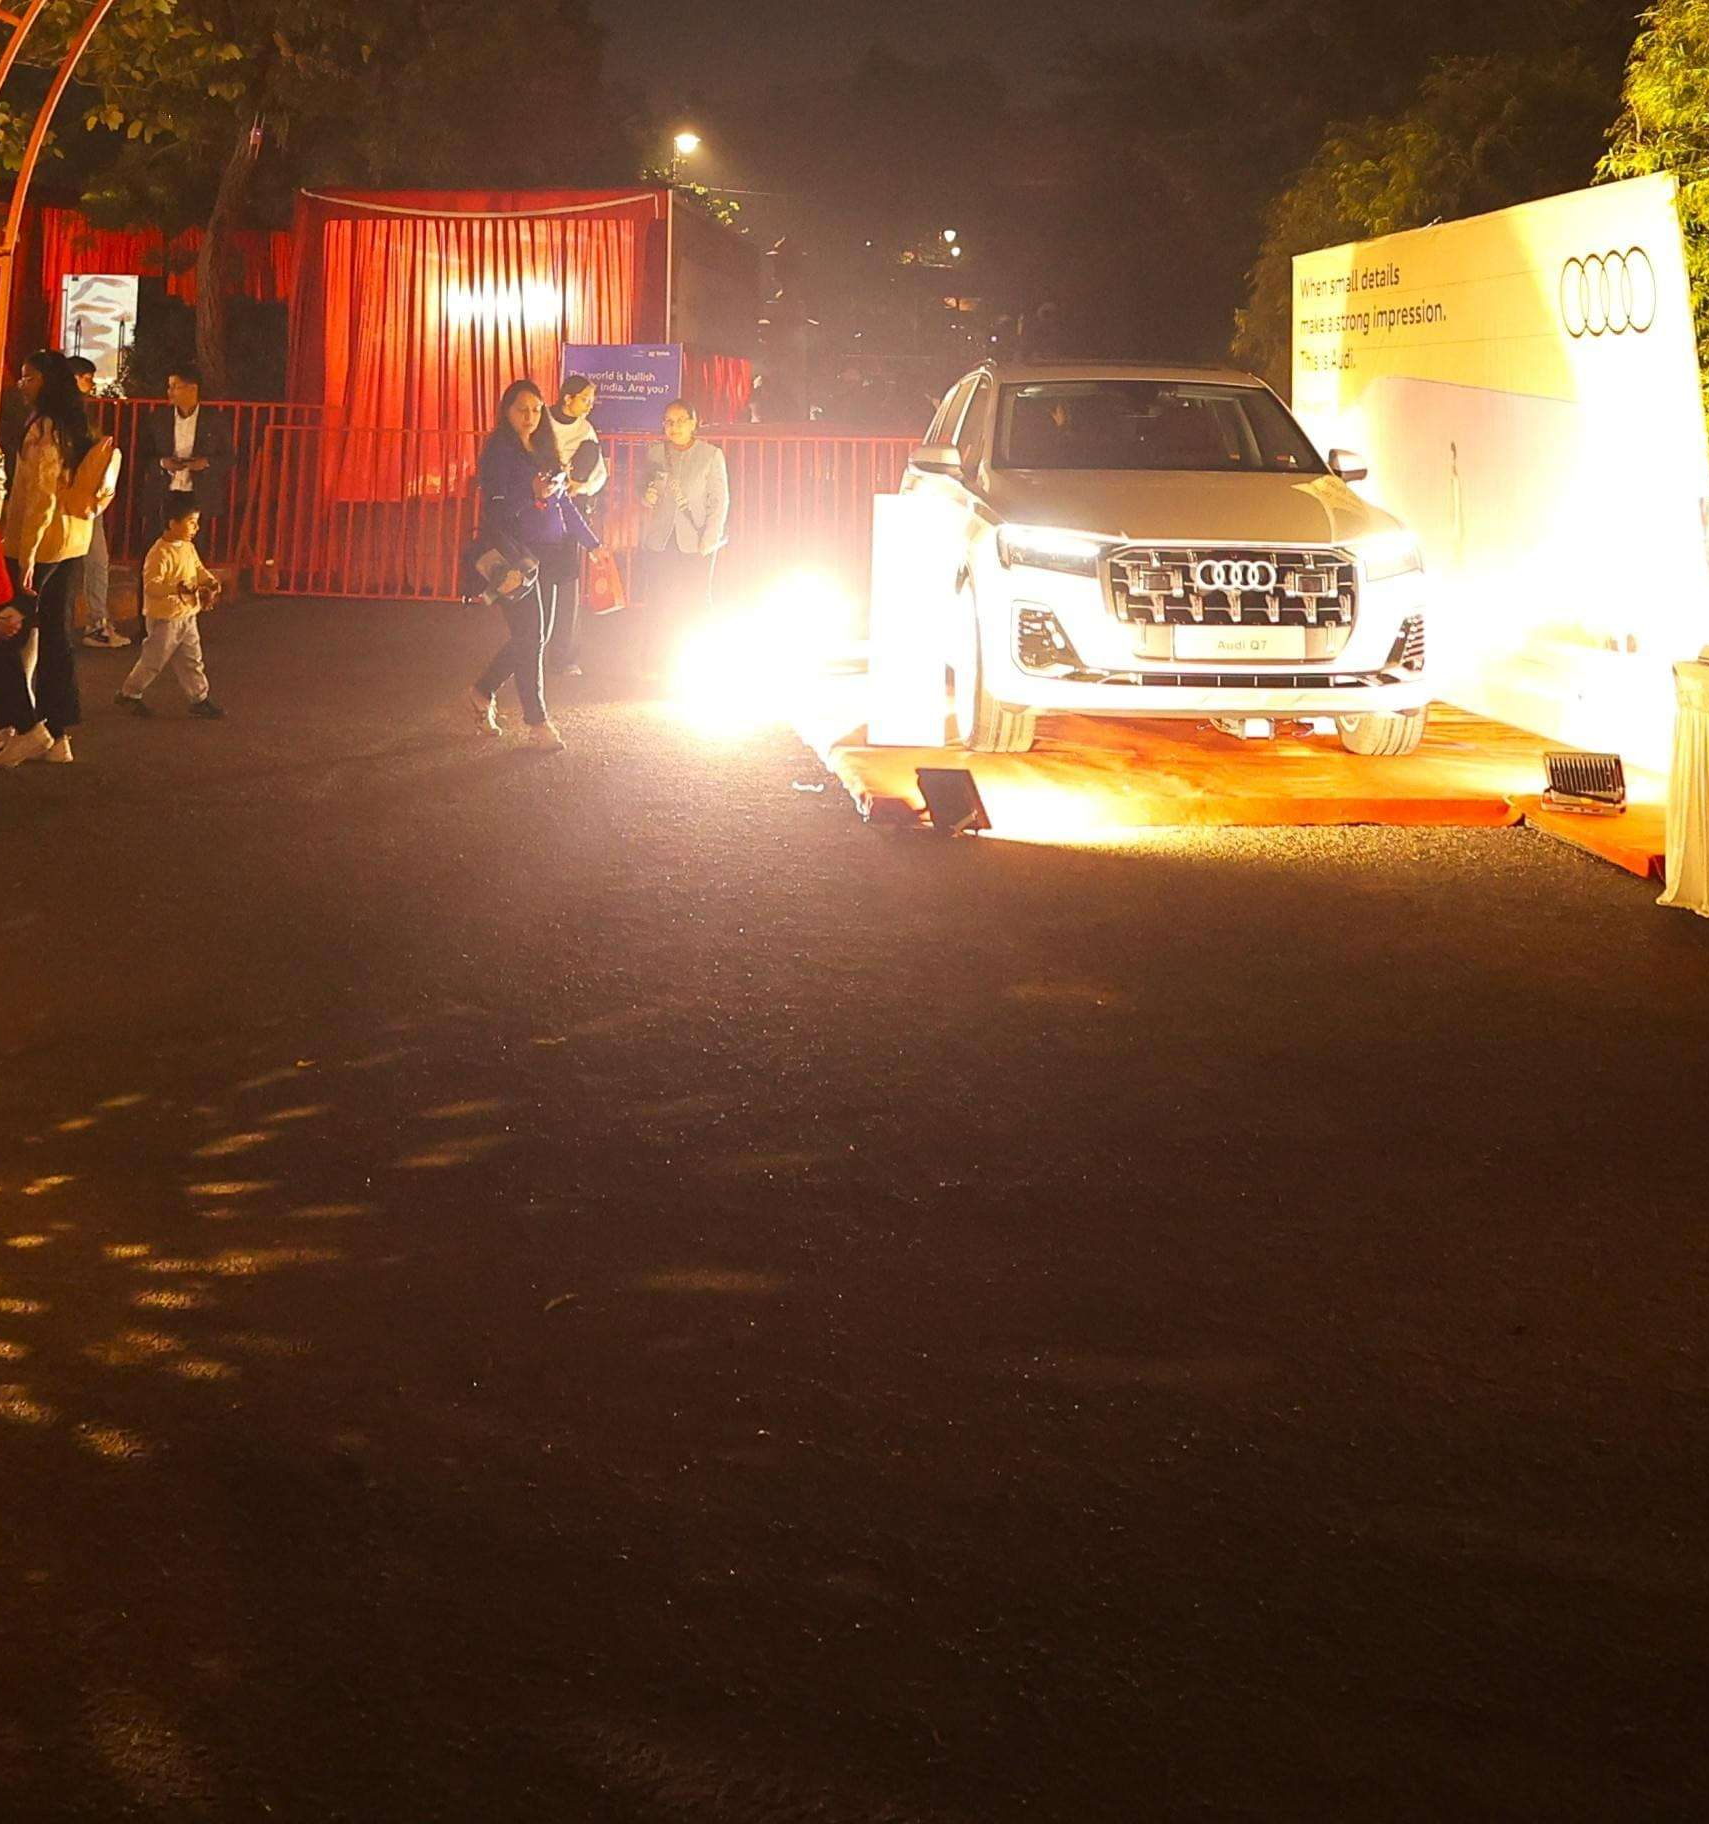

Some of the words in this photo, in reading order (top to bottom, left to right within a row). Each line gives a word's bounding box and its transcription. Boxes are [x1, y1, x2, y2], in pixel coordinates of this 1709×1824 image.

[1300, 276, 1327, 298] When
[1330, 269, 1358, 295] small
[1362, 263, 1400, 290] details
[1300, 312, 1324, 334] make
[1336, 311, 1370, 336] strong
[1373, 298, 1447, 333] impression.
[617, 371, 624, 381] is
[626, 371, 655, 381] bullish
[628, 383, 646, 393] Are
[647, 384, 670, 395] you?
[1217, 639, 1246, 651] Audi
[1249, 639, 1268, 651] Q7
